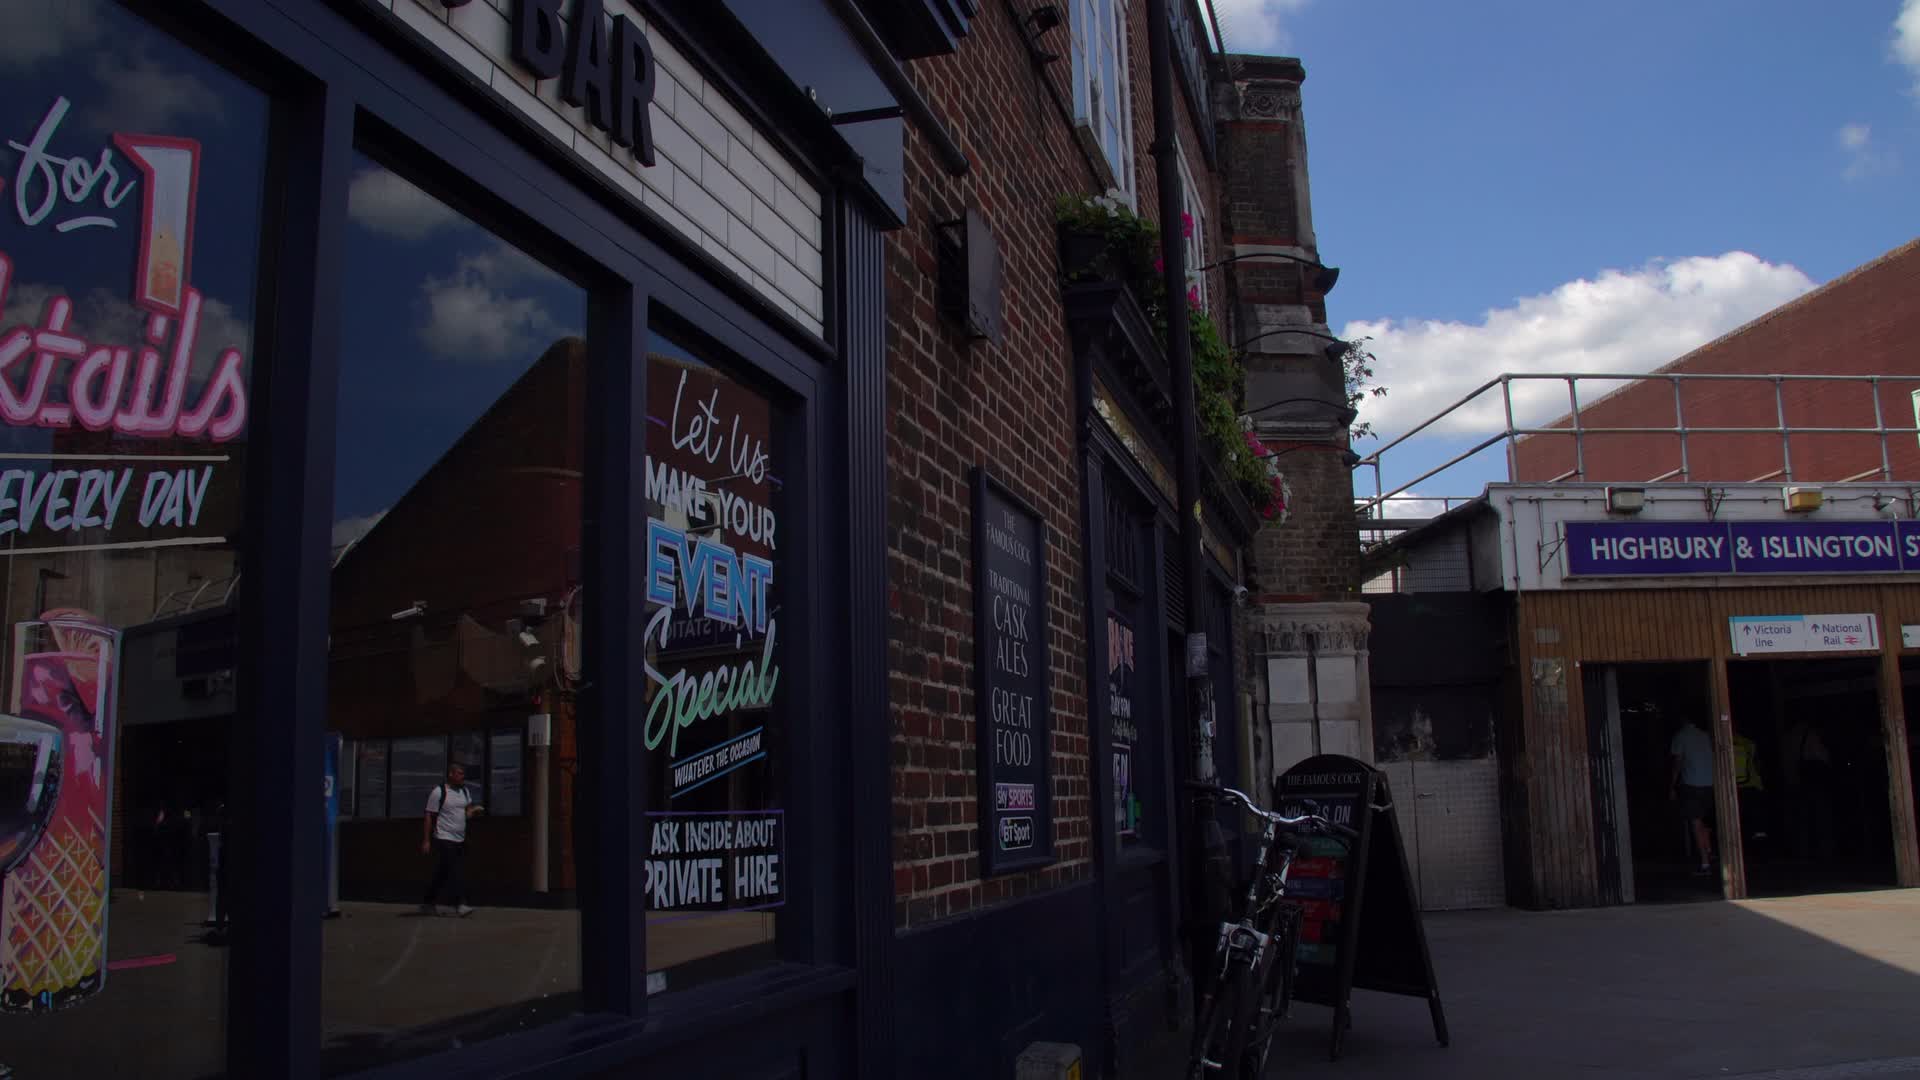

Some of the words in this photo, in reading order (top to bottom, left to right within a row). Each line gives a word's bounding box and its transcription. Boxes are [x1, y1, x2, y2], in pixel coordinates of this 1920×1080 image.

[8, 96, 136, 227] for
[112, 132, 201, 318] 1
[671, 368, 723, 464] Let
[138, 464, 214, 529] DAY
[644, 455, 707, 521] MAKE
[718, 487, 776, 550] YOUR
[1002, 510, 1016, 533] THE
[985, 520, 1014, 555] FAMOUS
[1014, 539, 1032, 567] COCK
[1590, 535, 1724, 560] HIGHBURY
[1736, 536, 1753, 559] &
[1760, 534, 1893, 558] ISLINGTON
[1905, 534, 1920, 557] S
[646, 516, 774, 641] EVENT
[988, 568, 1032, 607] TRADITIONAL
[993, 594, 1029, 642] CASK
[1754, 624, 1792, 635] Victoria
[1822, 623, 1863, 633] National
[996, 634, 1029, 678] ALES
[1755, 637, 1774, 647] line
[1823, 635, 1841, 645] Rail
[644, 606, 780, 758] Special
[991, 686, 1033, 729] GREAT
[674, 754, 715, 789] WHATEVER
[716, 747, 729, 769] THE
[729, 733, 762, 763] OCCASION
[996, 728, 1032, 767] FOOD
[1008, 787, 1033, 807] SPORTS
[1334, 805, 1352, 824] ON
[651, 820, 680, 856] ASK
[684, 818, 732, 854] INSIDE
[734, 818, 777, 850] ABOUT
[1003, 827, 1014, 842] BT
[1014, 823, 1031, 842] Sport
[734, 854, 780, 900] HIRE
